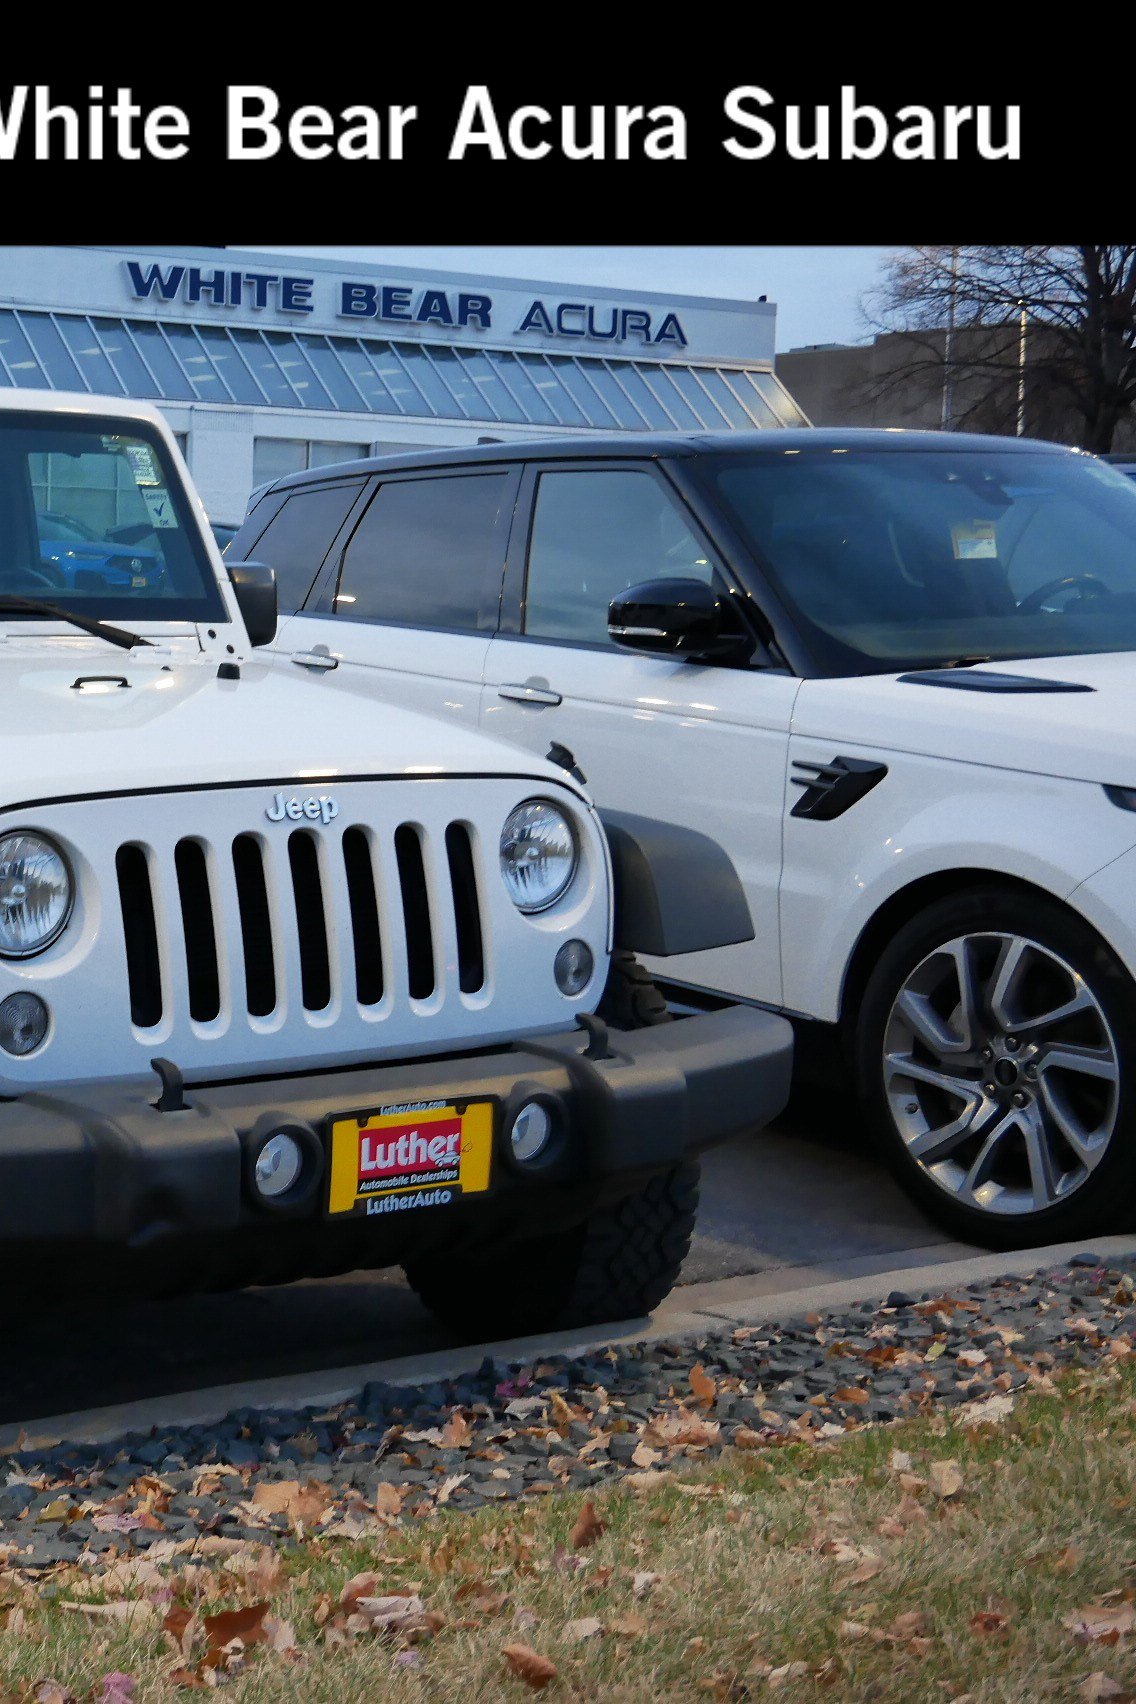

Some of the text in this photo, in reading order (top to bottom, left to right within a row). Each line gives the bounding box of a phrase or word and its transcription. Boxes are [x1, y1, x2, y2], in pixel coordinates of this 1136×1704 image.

[126, 261, 688, 346] WHITE BEAR ACURA
[265, 792, 339, 825] Jeep
[360, 1130, 461, 1171] Luther
[359, 1169, 459, 1192] Automobile Dealerships
[366, 1188, 452, 1216] LutherAuto
